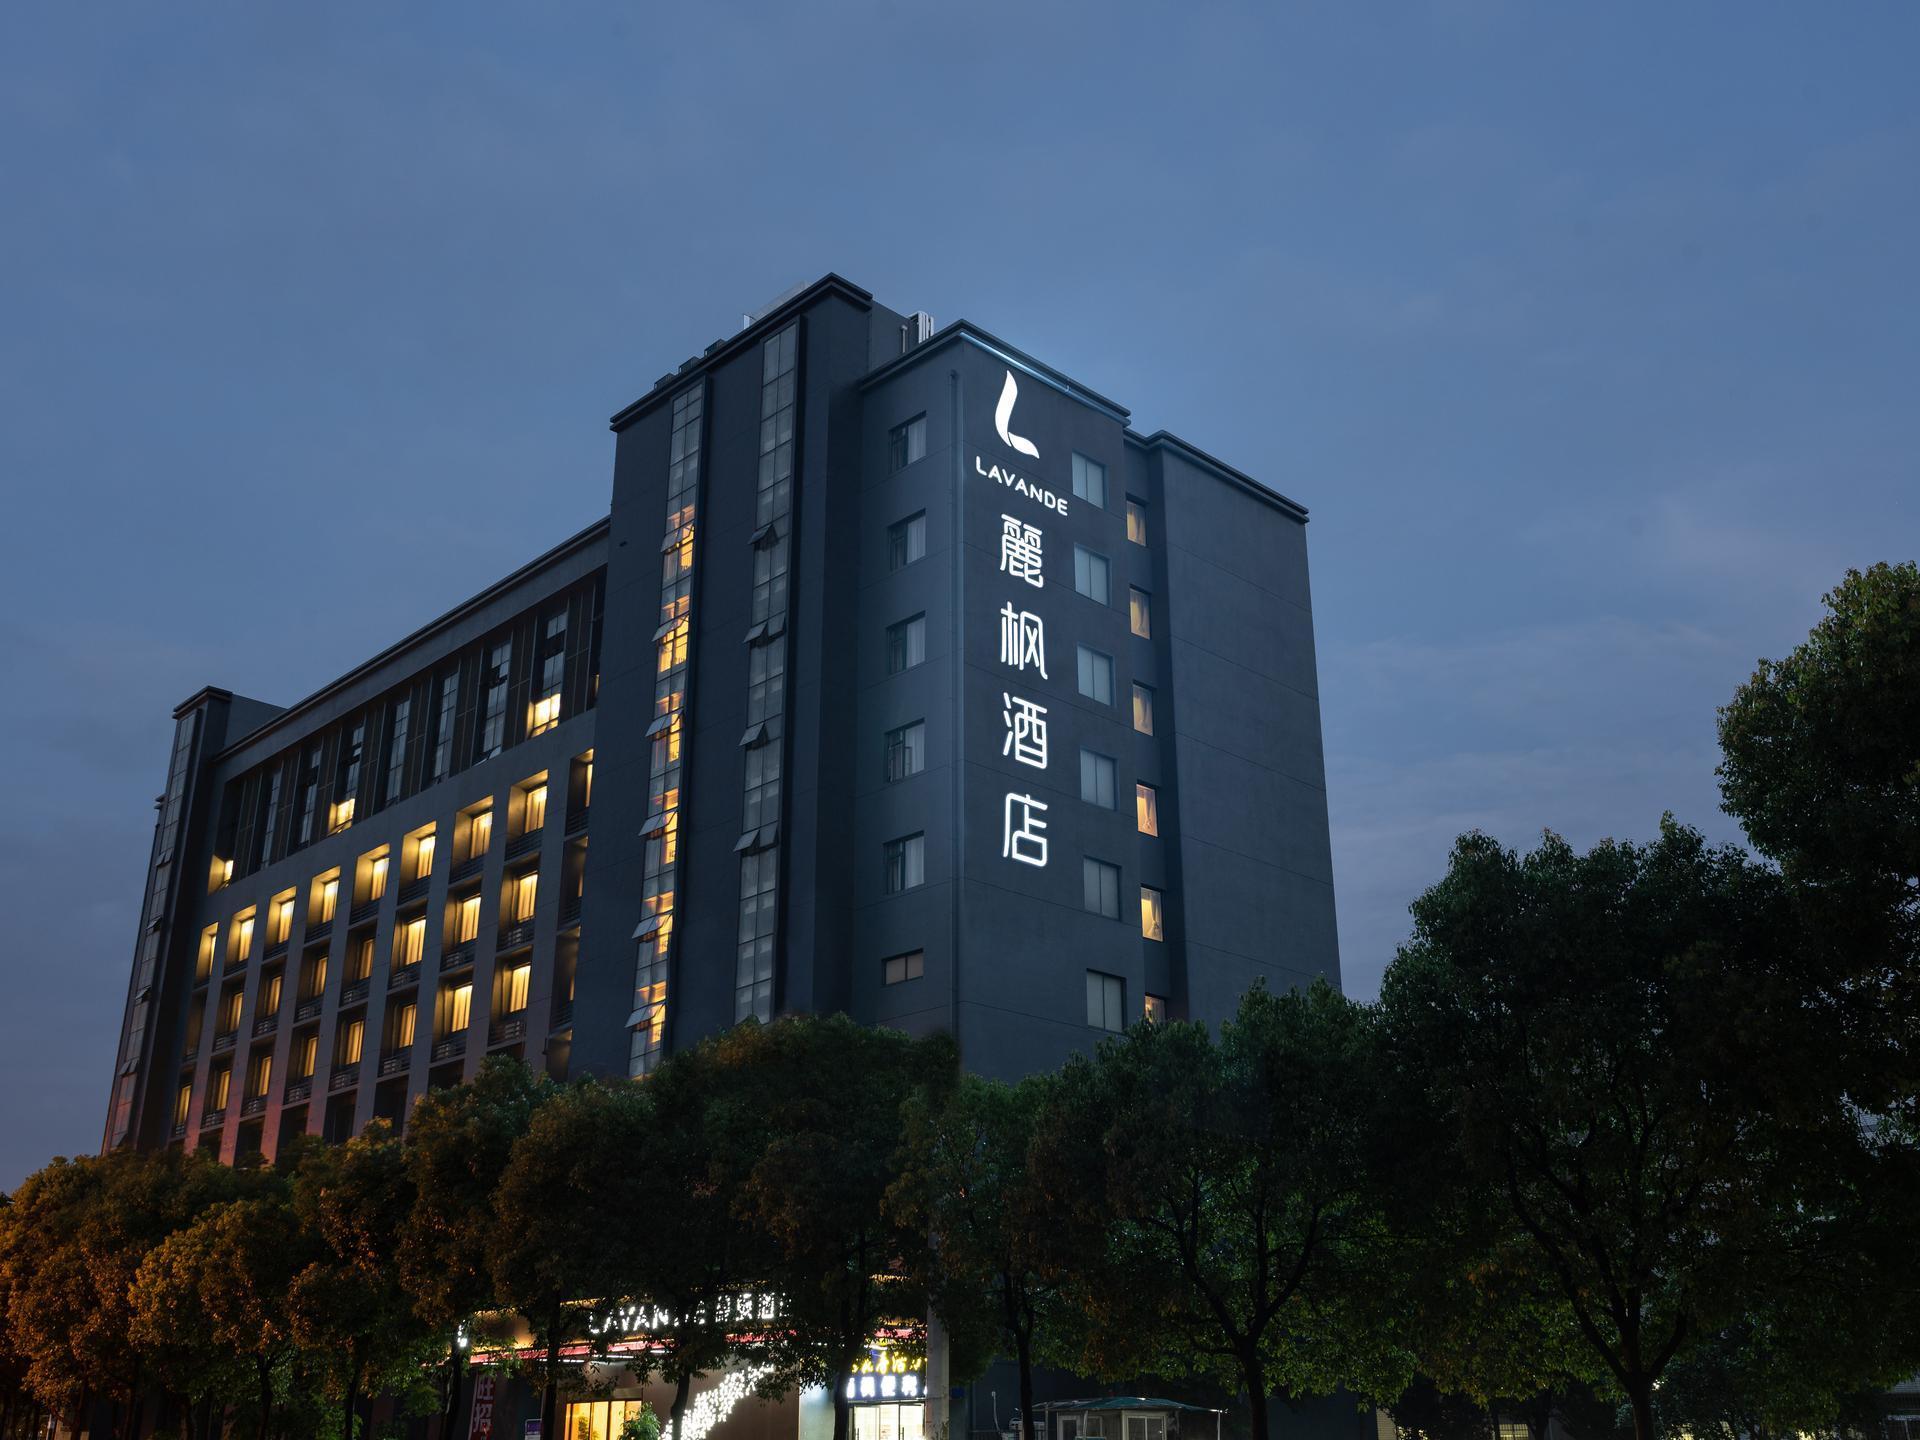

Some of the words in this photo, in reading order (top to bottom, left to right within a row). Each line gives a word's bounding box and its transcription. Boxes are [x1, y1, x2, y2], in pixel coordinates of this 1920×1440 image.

[975, 455, 1069, 517] LAVANDE
[1000, 513, 1048, 868] 麗枫酒店
